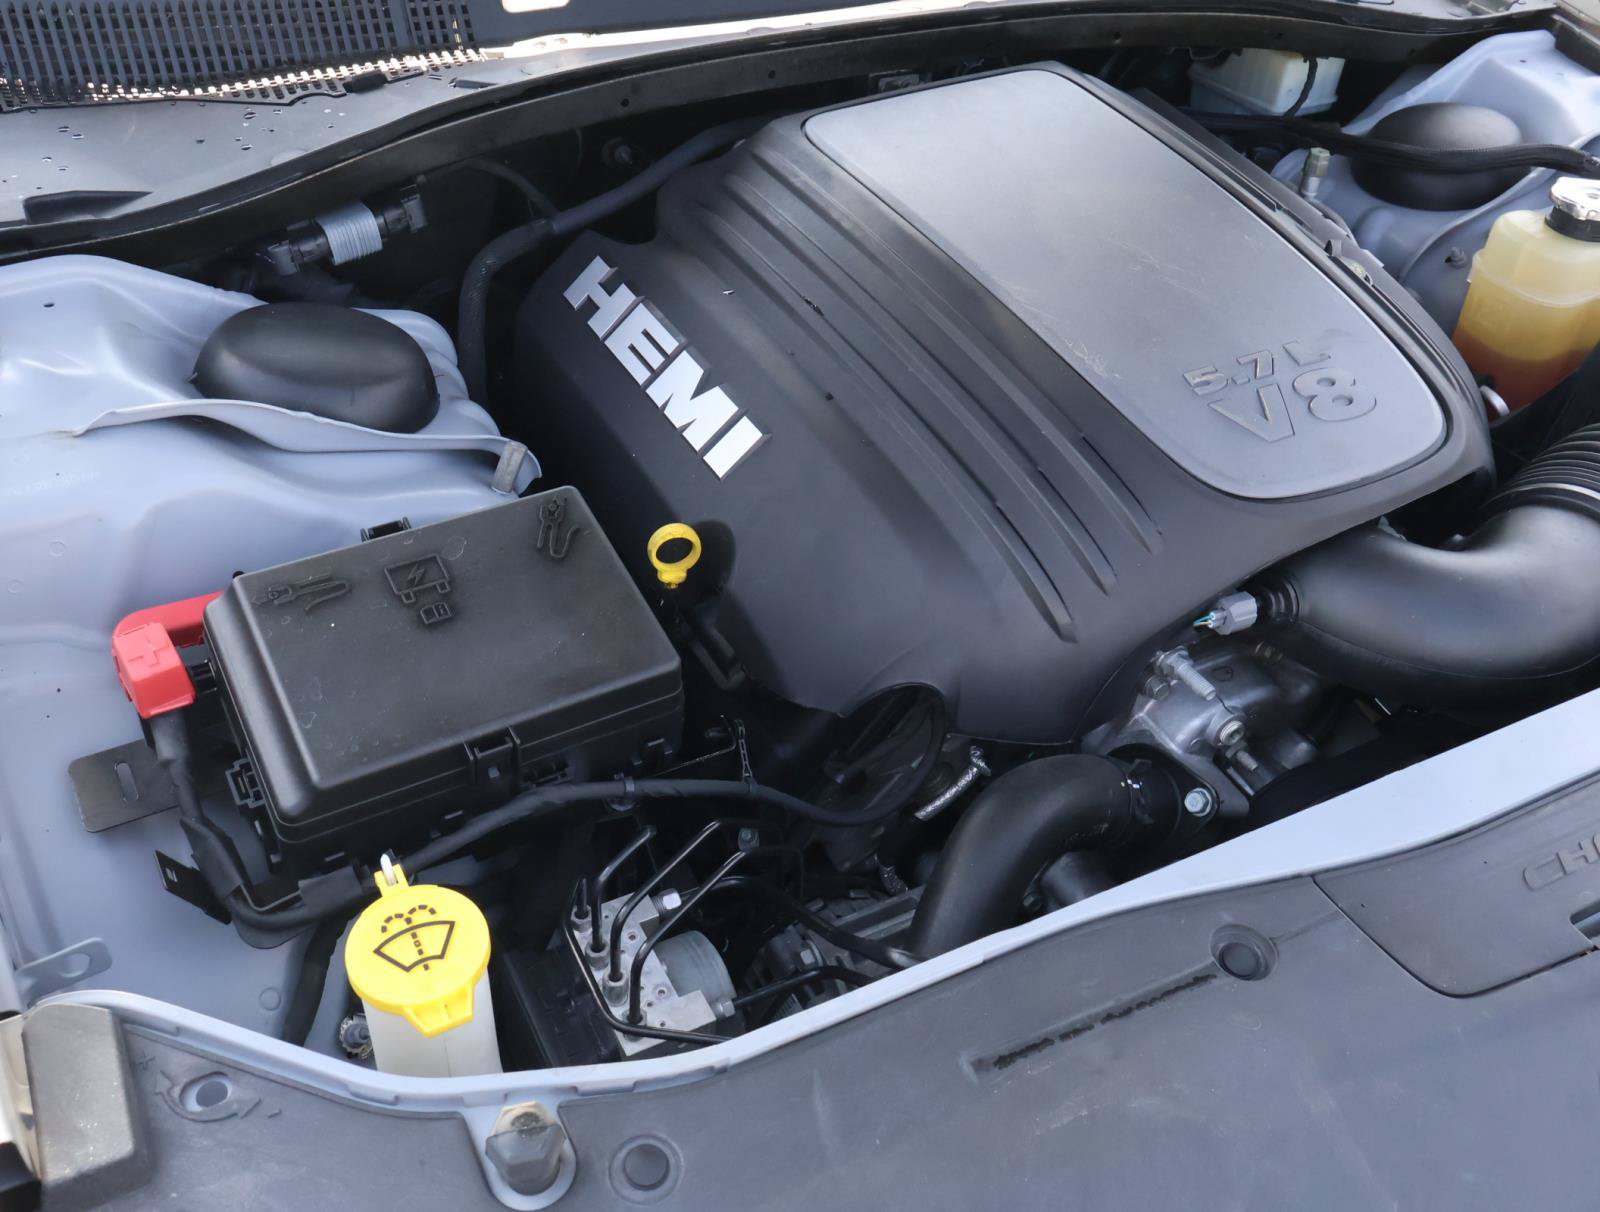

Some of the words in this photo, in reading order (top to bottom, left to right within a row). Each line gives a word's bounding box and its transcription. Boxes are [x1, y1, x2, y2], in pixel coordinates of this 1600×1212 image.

[563, 255, 765, 479] HEMI
[1183, 340, 1333, 396] 5.7L
[1208, 366, 1377, 443] V8
[1522, 832, 1600, 892] CH
